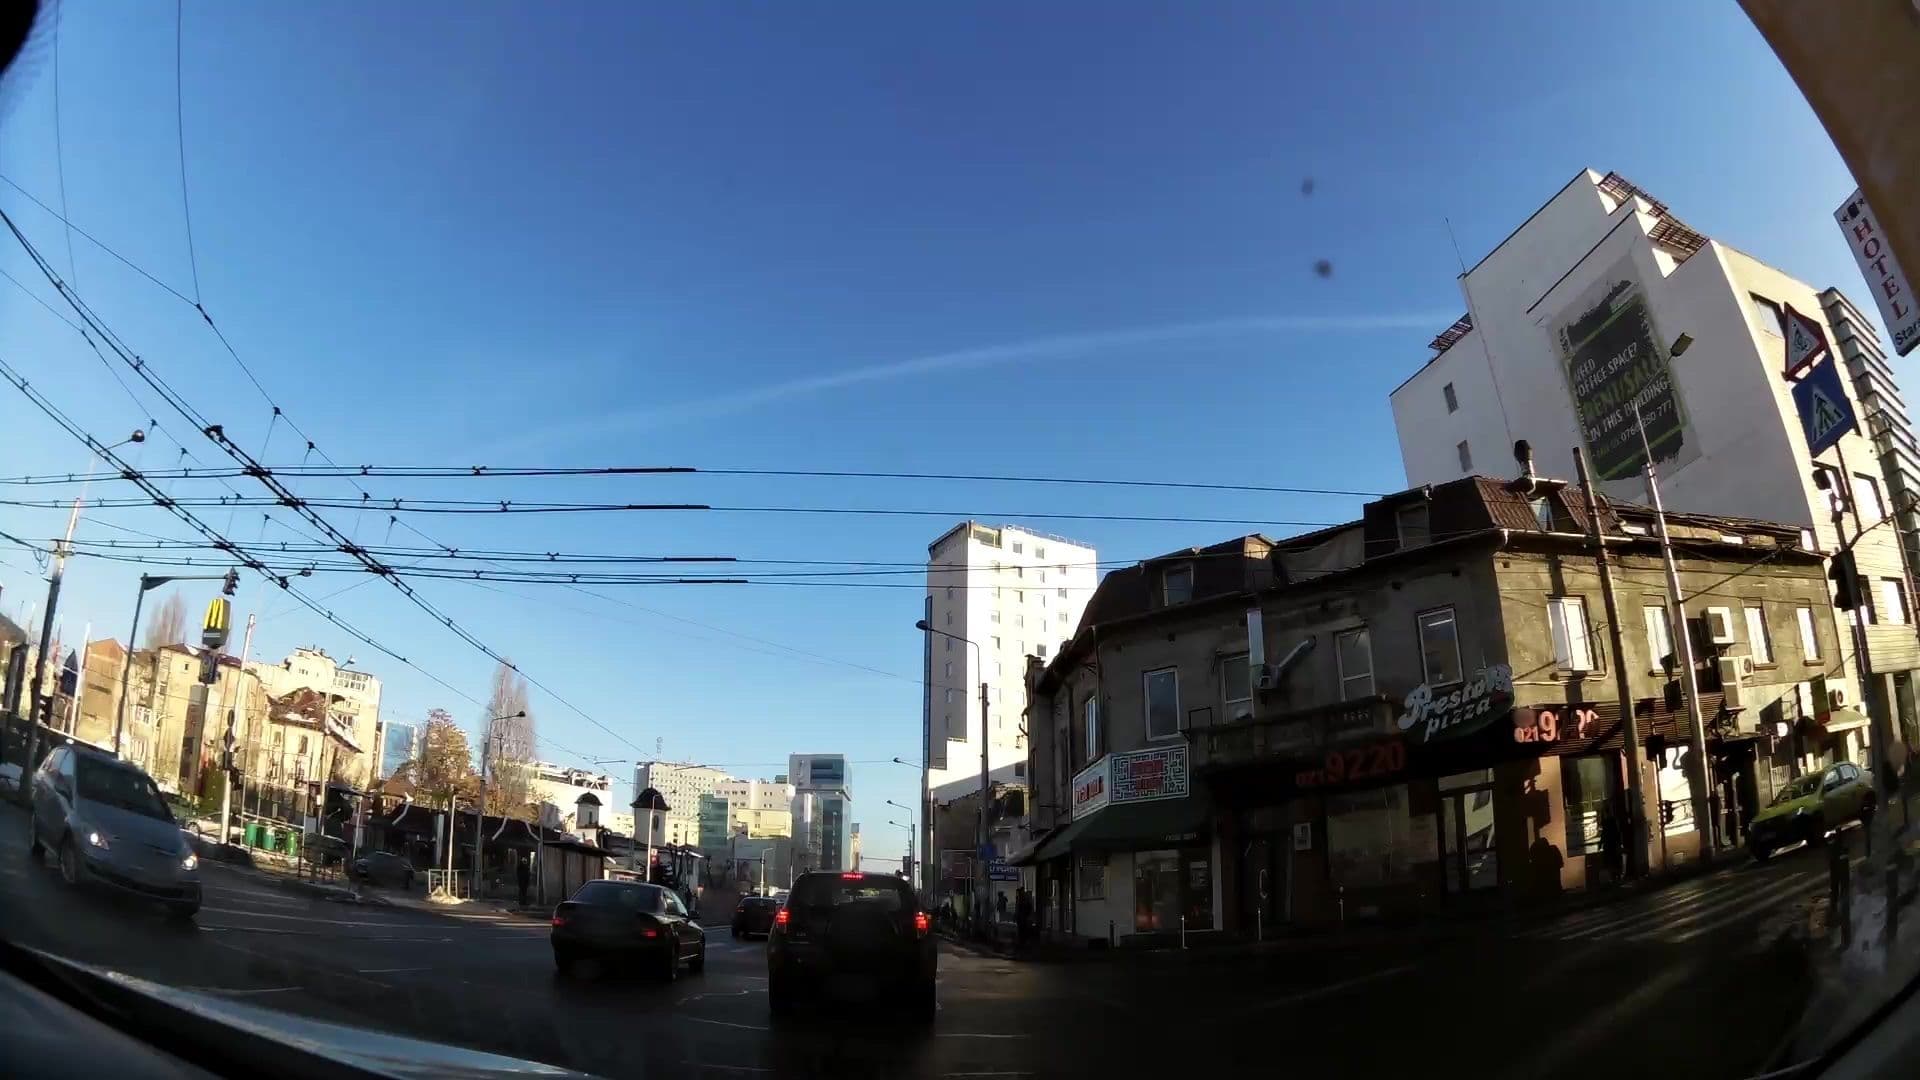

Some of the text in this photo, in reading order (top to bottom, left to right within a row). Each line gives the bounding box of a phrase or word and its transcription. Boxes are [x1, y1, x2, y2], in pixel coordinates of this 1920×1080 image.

[1853, 217, 1909, 321] HOTEL
[1576, 343, 1638, 397] OFFICE SPACE?
[1589, 376, 1669, 442] IN THIS BUILDING
[1397, 679, 1486, 730] Presto
[1424, 697, 1491, 743] pizza
[1326, 741, 1406, 784] 9220
